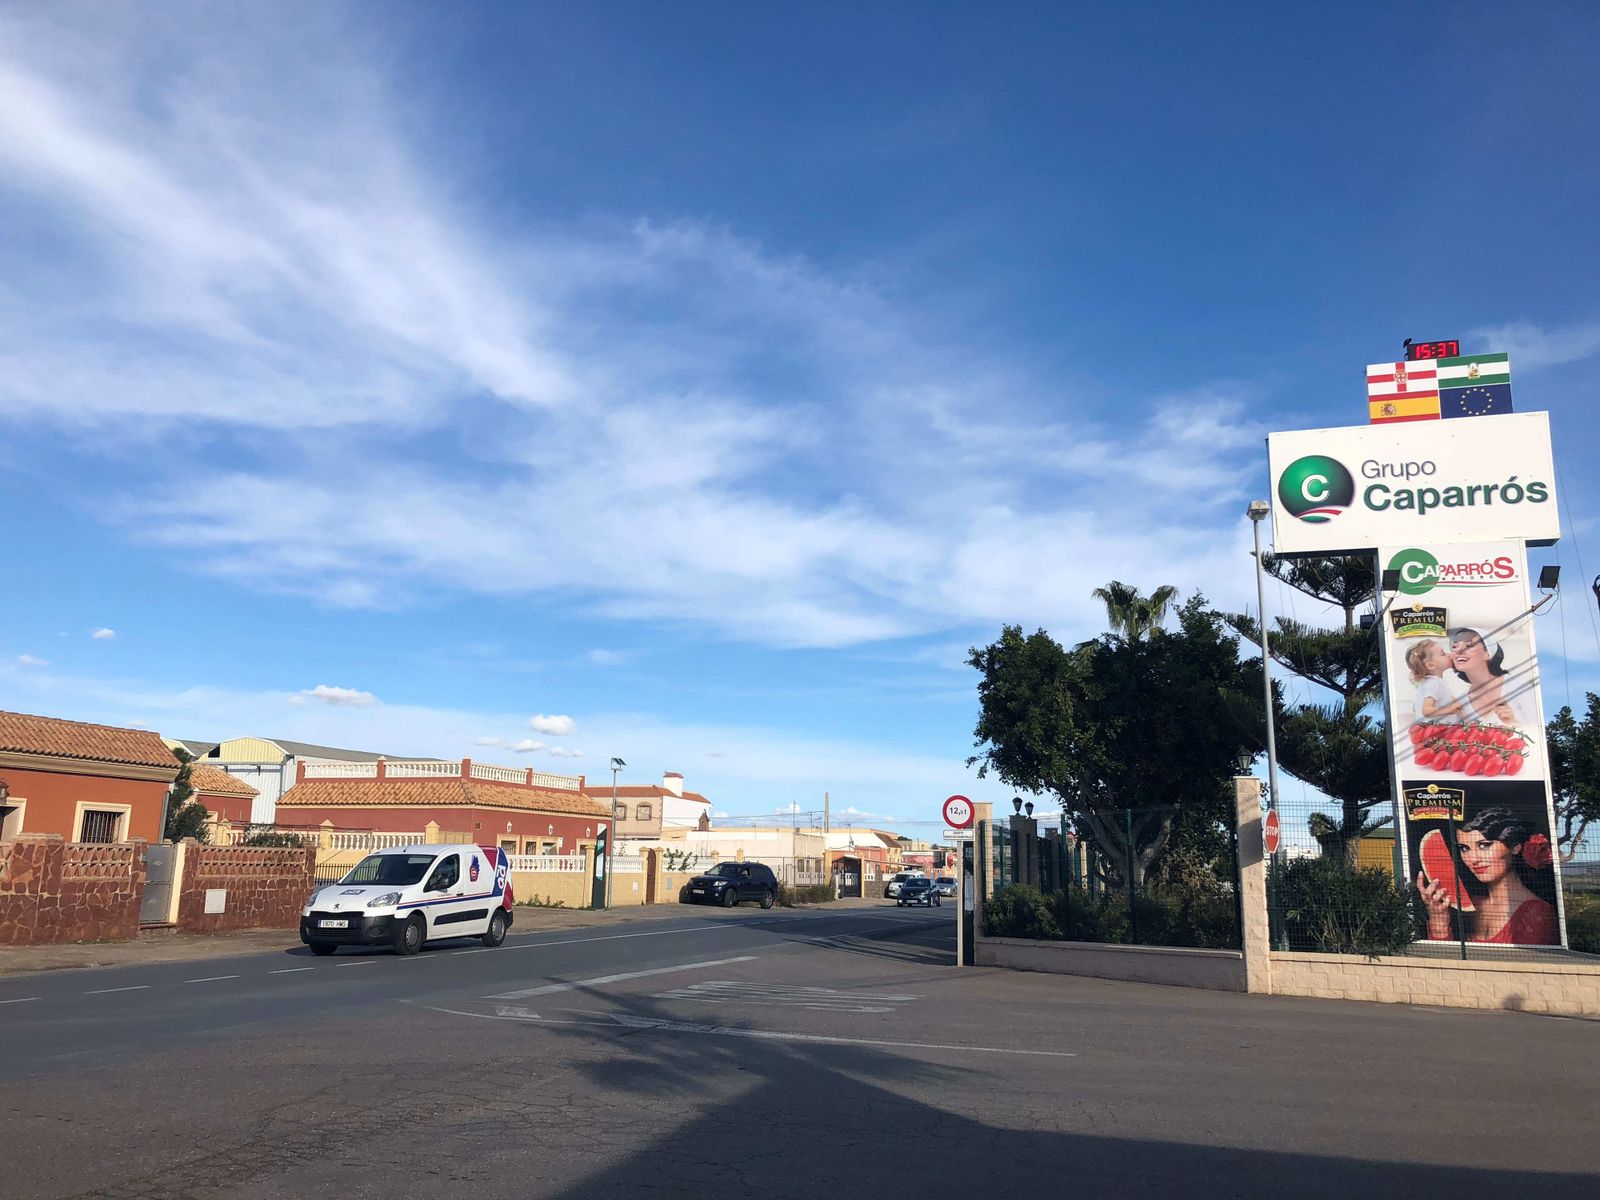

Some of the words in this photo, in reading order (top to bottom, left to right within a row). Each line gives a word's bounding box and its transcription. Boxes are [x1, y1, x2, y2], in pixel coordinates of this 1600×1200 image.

[1415, 341, 1457, 359] 15:37
[1361, 459, 1436, 480] Grupo
[1363, 476, 1549, 515] Caparrós
[1401, 556, 1514, 583] CAPARRÓS
[1393, 615, 1445, 624] PREMIUM
[1407, 799, 1461, 807] PREMIUM
[1416, 792, 1451, 800] Caparrós
[1266, 825, 1278, 837] STOP
